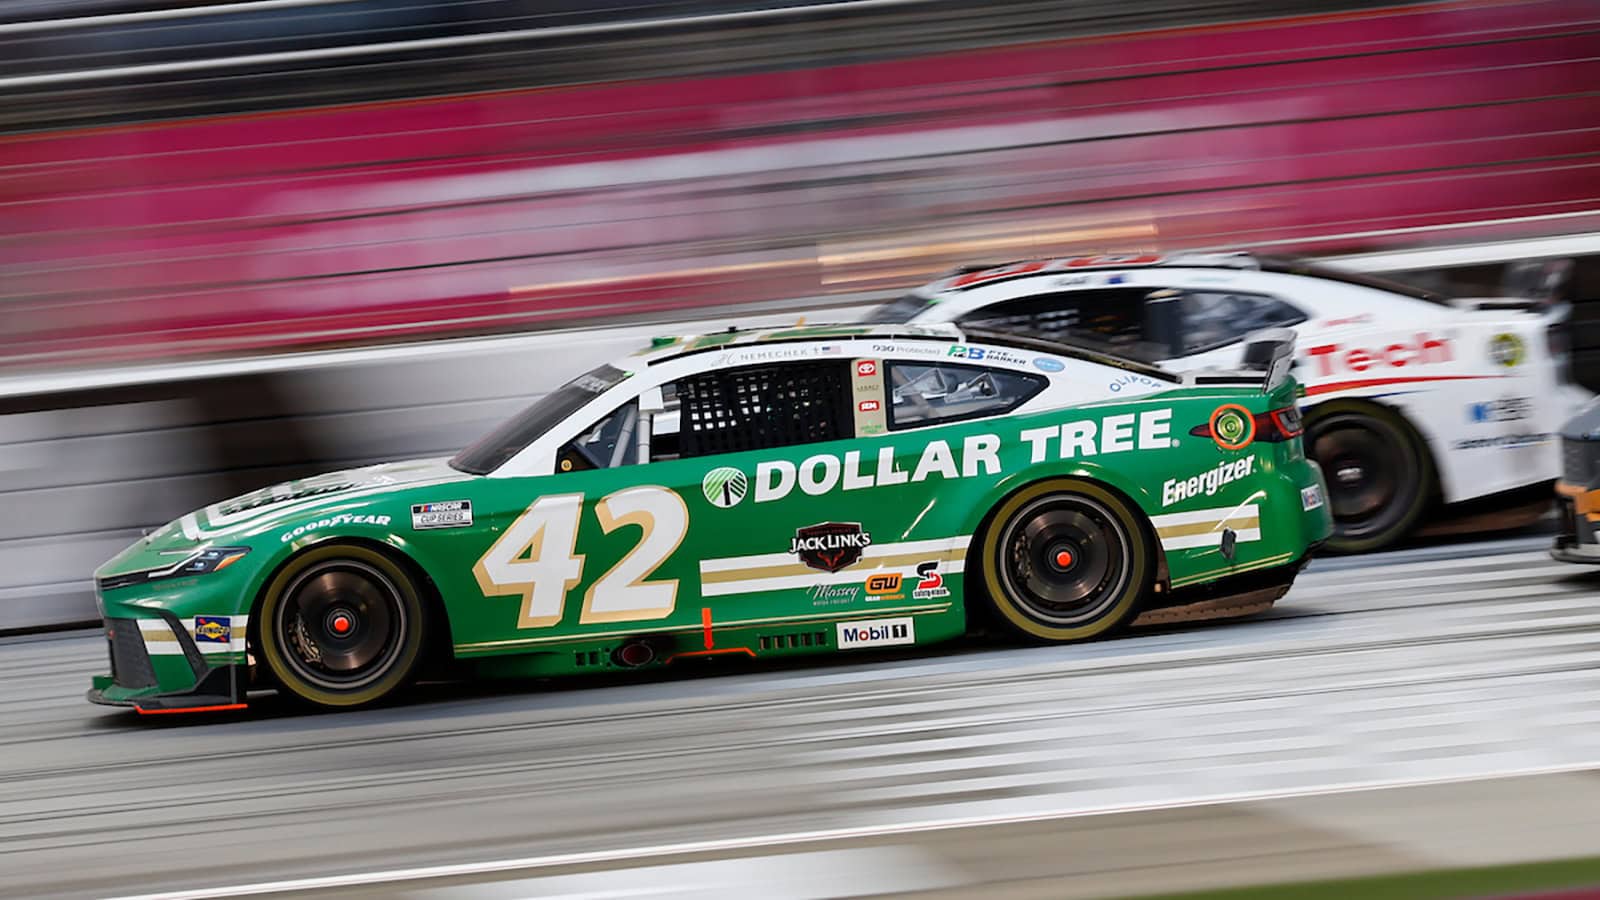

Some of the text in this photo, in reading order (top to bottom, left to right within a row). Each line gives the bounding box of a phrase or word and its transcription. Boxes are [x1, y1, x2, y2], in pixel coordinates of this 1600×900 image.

[740, 348, 808, 361] NEMECHEK
[1306, 331, 1453, 377] Tech
[754, 408, 1173, 503] DOLLAR TREE
[1162, 454, 1256, 507] Energizer
[432, 501, 461, 513] NASCAR
[281, 511, 392, 543] GOODYEAR
[421, 512, 463, 523] CUP SERIES
[789, 537, 827, 553] JACK
[472, 484, 690, 629] 42
[806, 583, 859, 603] Massey
[197, 625, 230, 635] SUNOCO
[844, 624, 889, 642] Mobil
